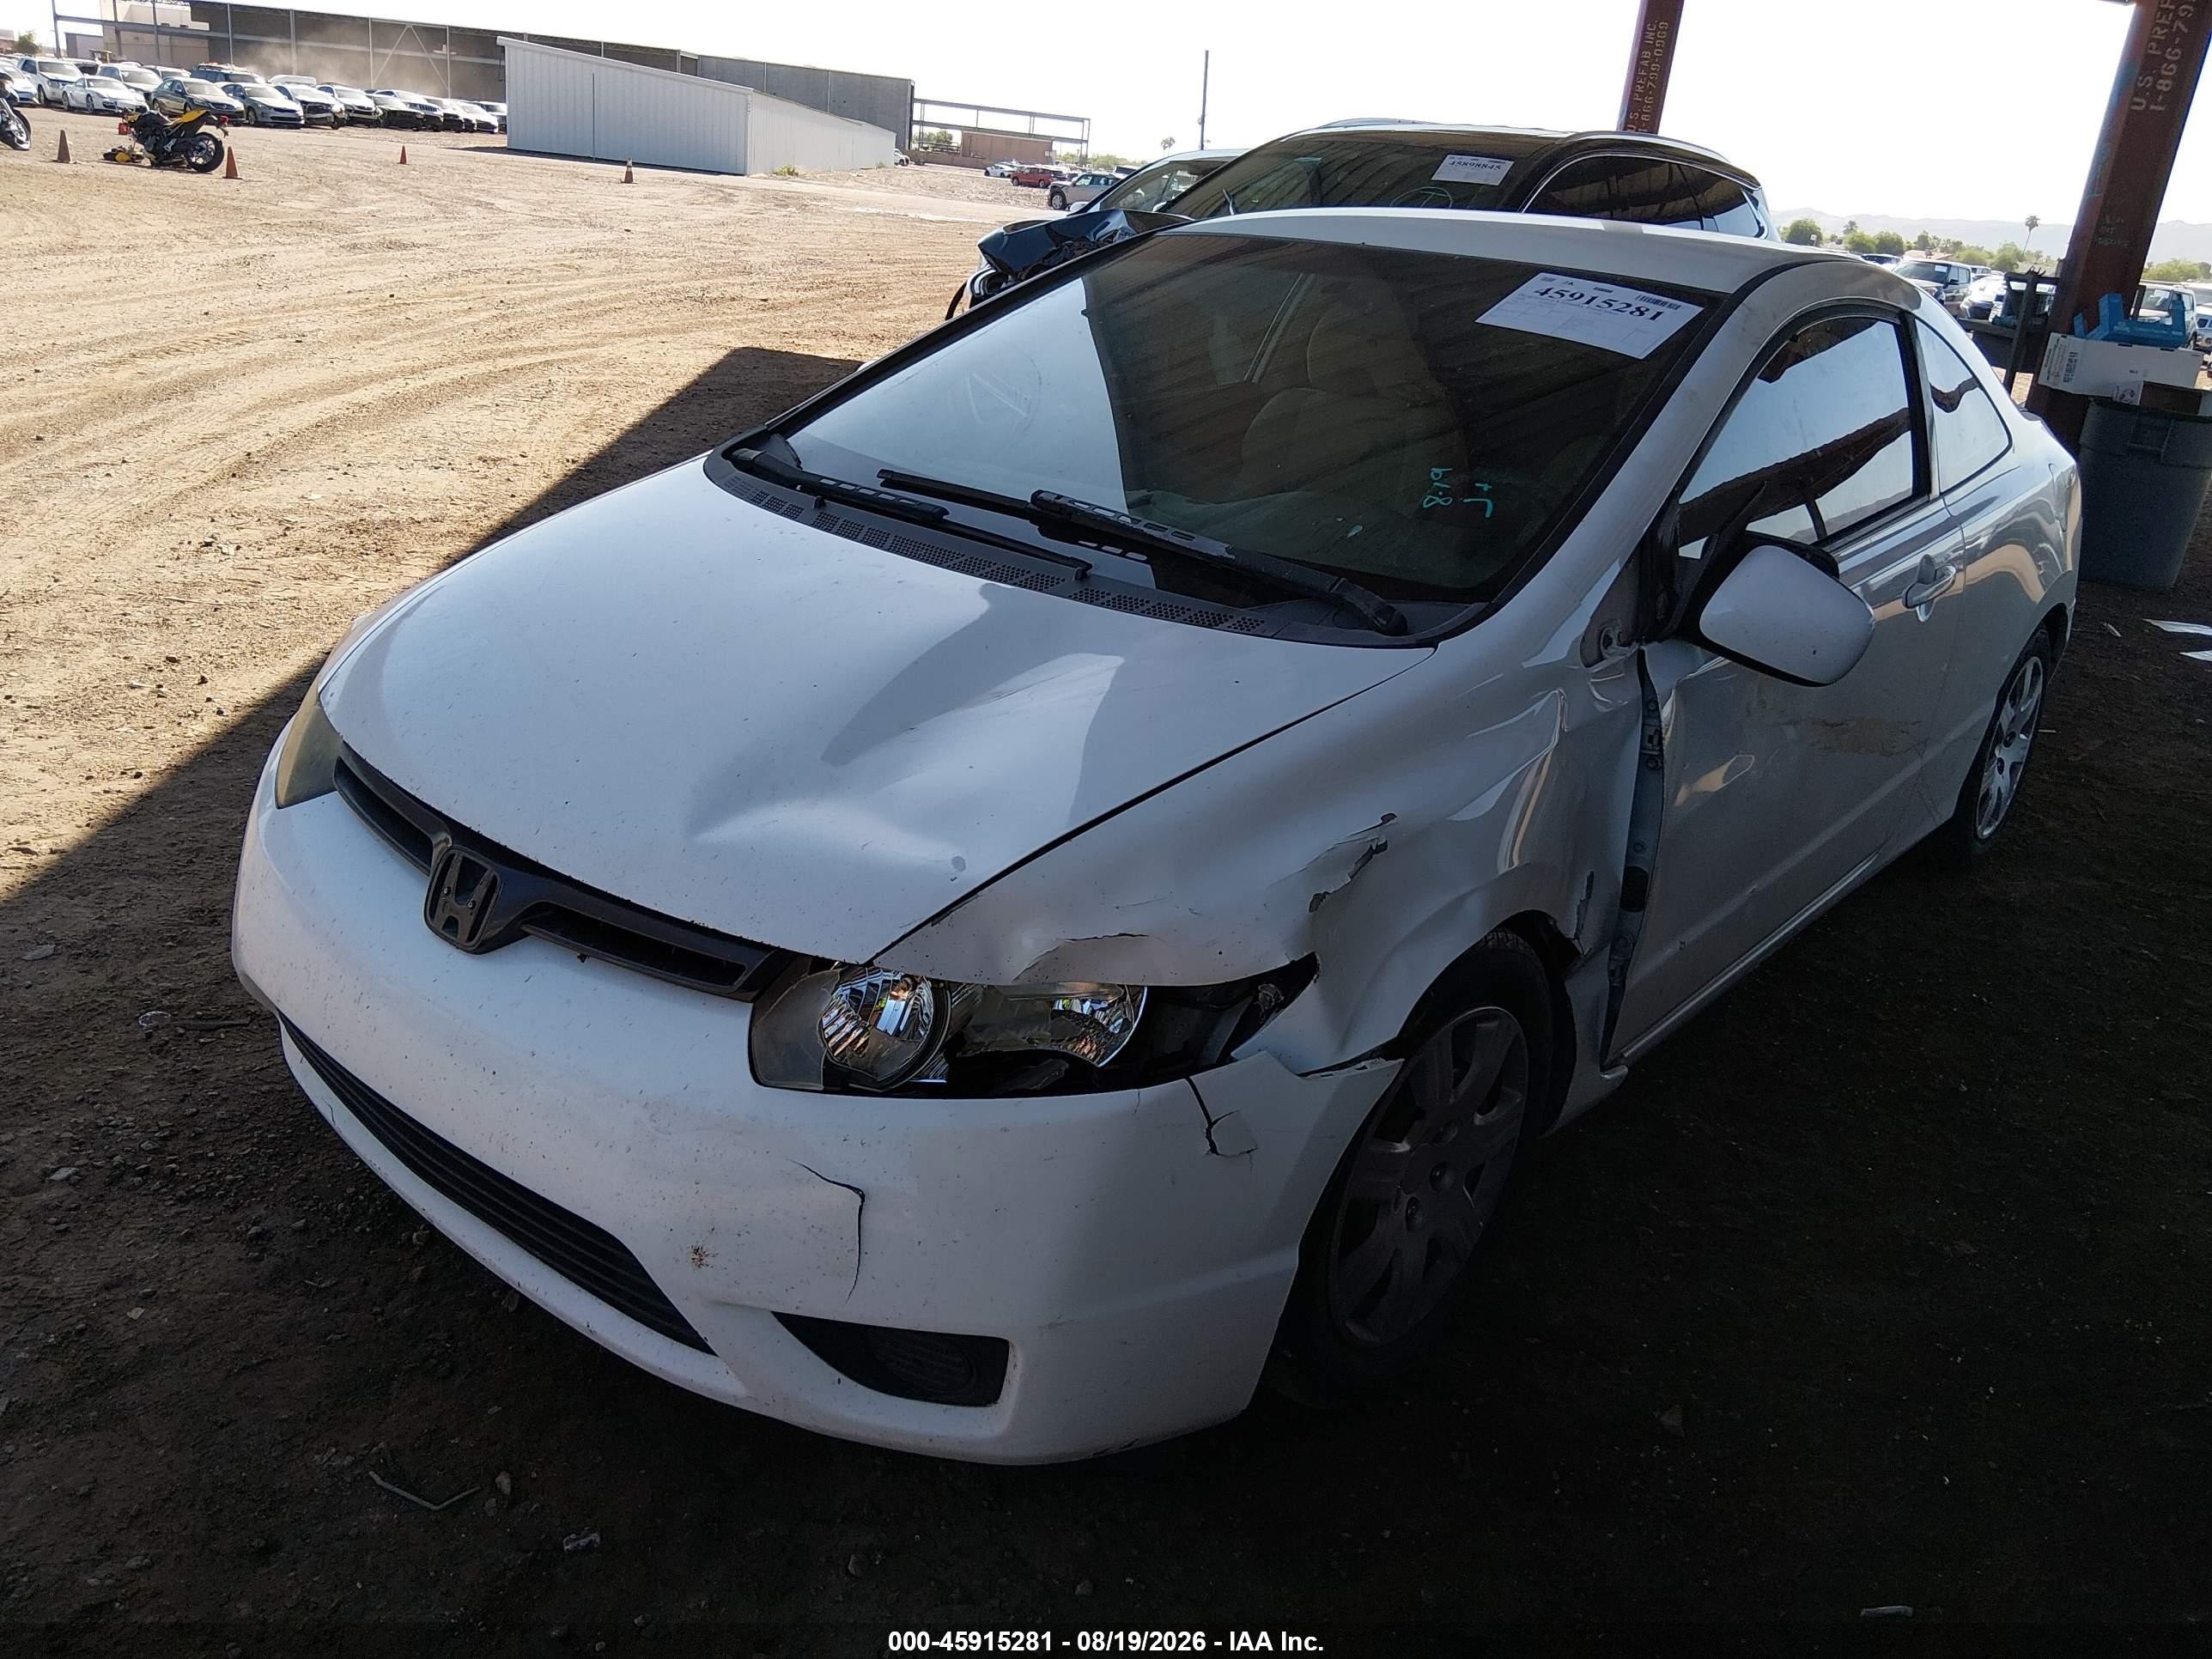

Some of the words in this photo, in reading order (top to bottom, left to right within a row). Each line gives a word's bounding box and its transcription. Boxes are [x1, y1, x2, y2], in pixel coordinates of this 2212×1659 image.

[1634, 51, 1651, 101] PREFAB
[1644, 20, 1658, 44] INC.
[2149, 0, 2197, 111] 1-866-79
[2130, 70, 2157, 111] U.S.
[1534, 286, 1664, 321] 45915281
